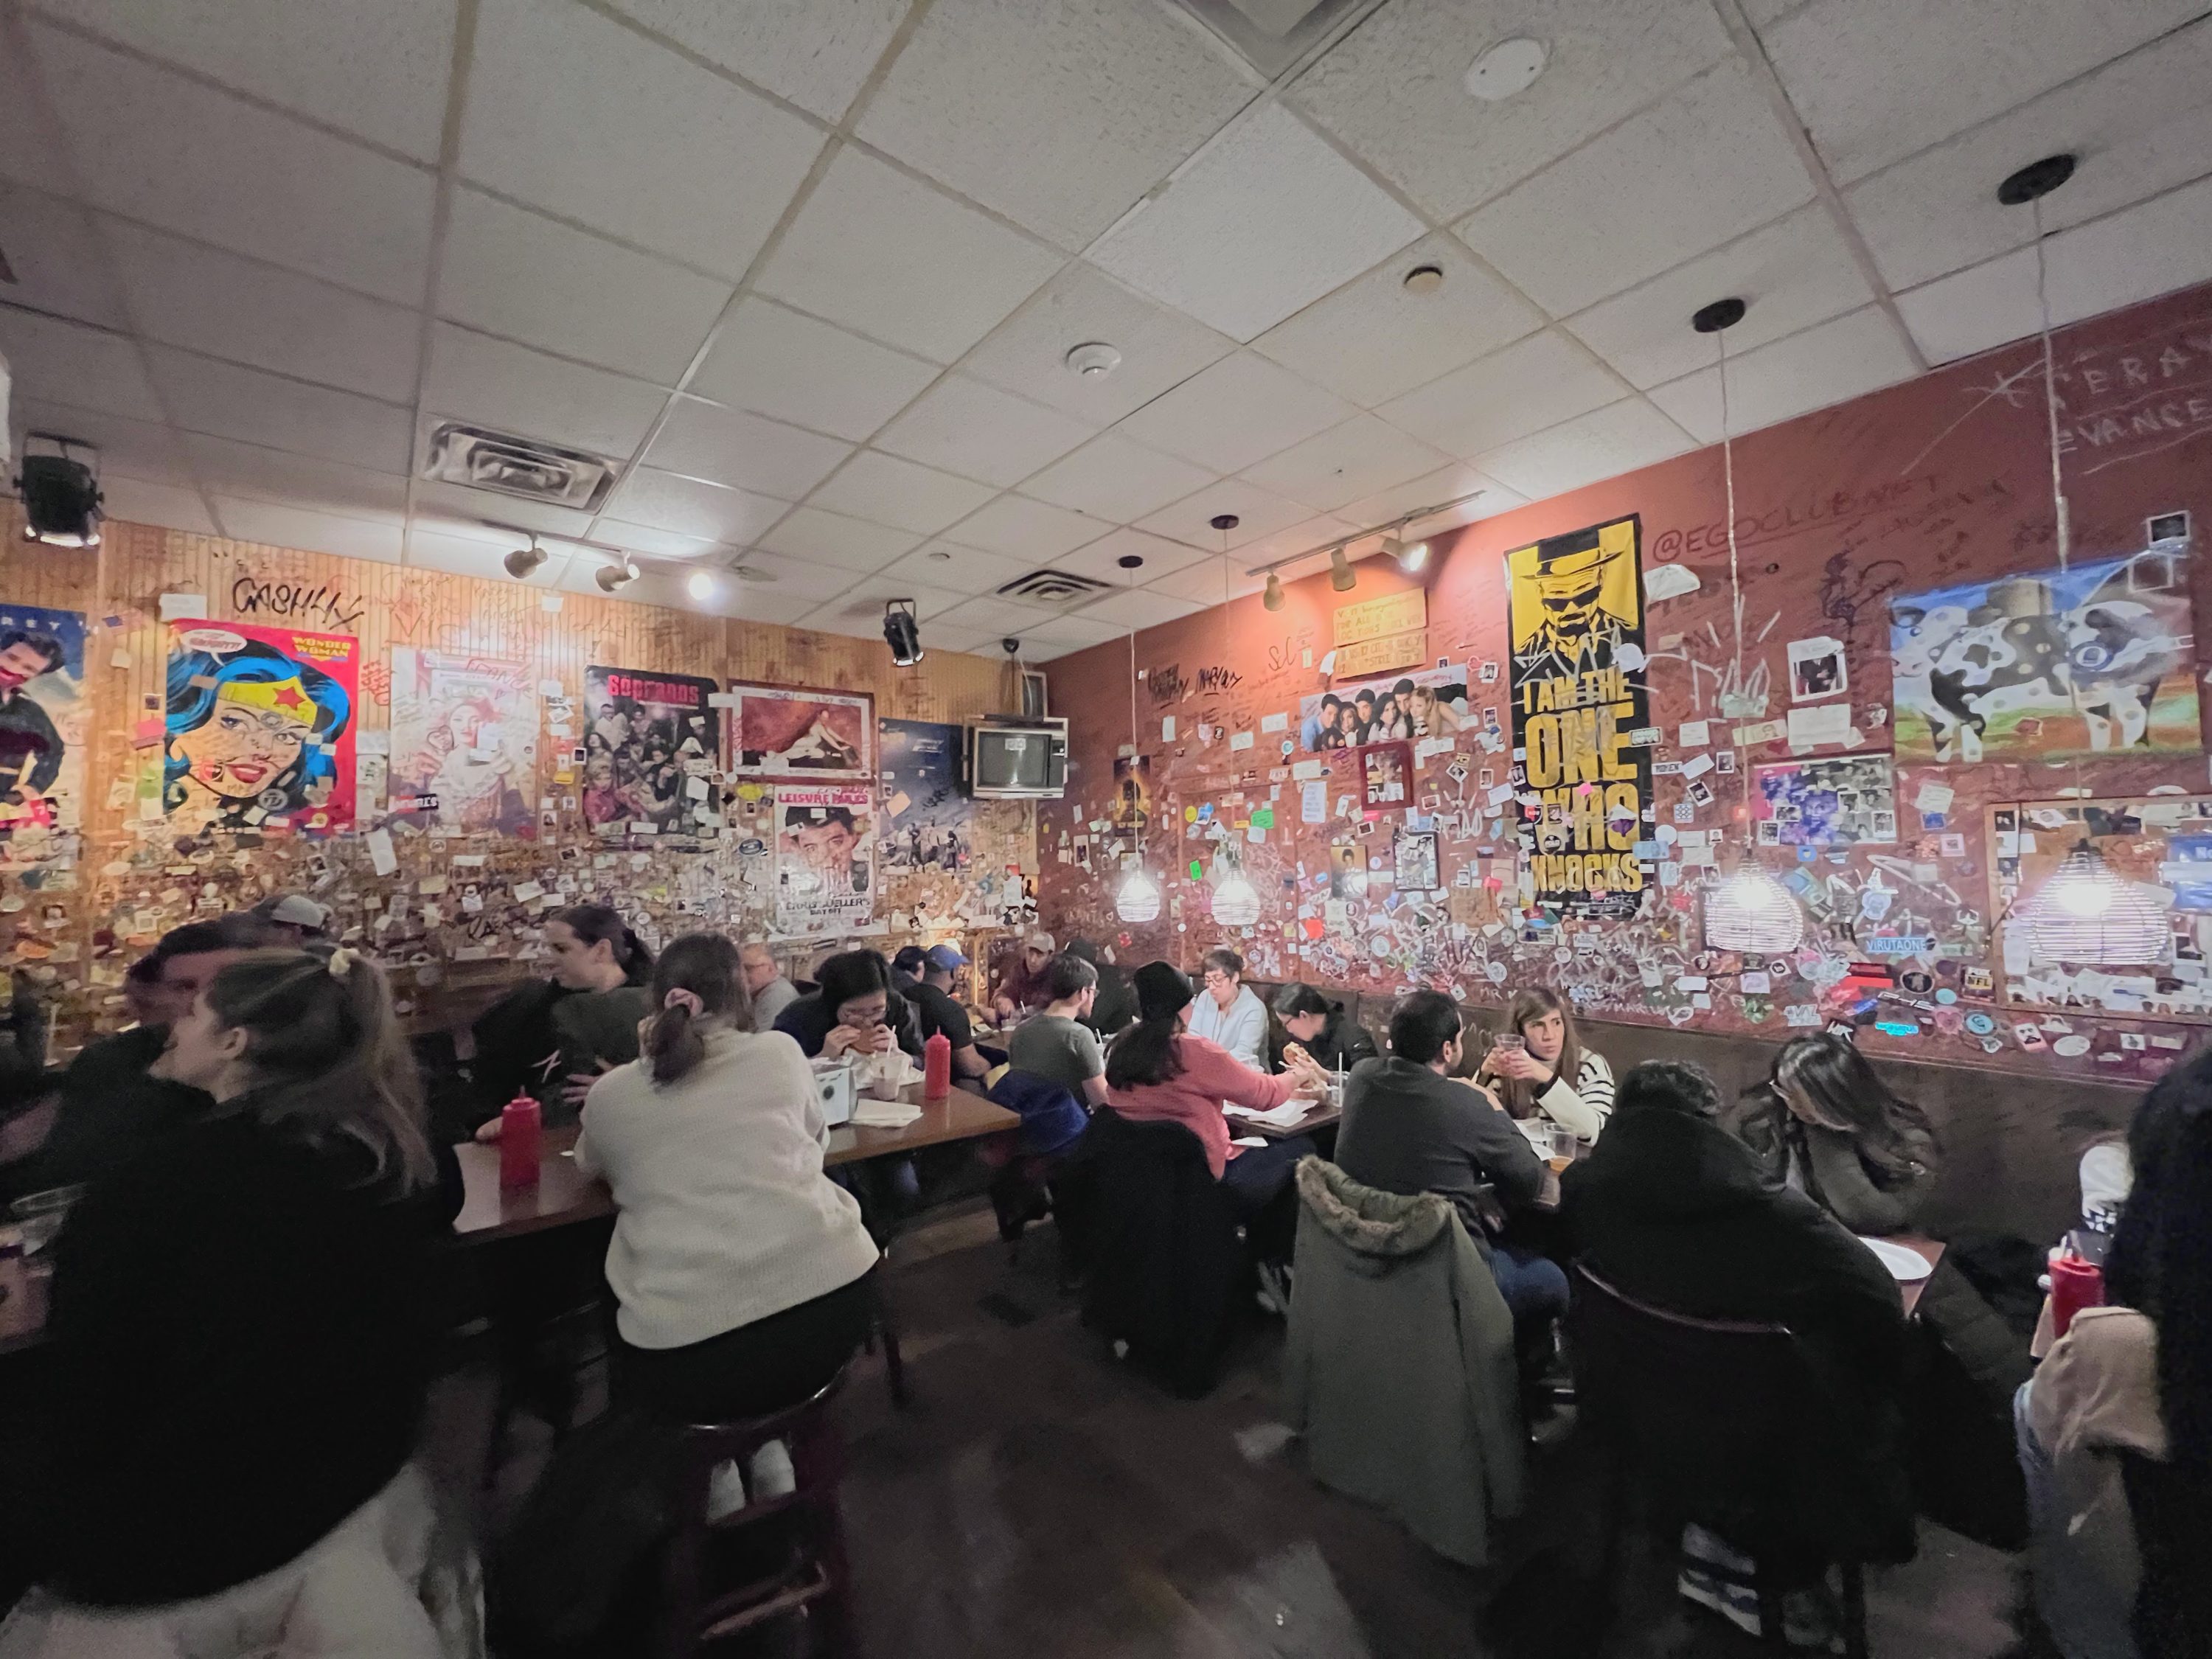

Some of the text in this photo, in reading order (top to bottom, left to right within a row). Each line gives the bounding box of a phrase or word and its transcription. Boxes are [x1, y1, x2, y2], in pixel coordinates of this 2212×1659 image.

[292, 637, 352, 651] WONDER
[294, 645, 349, 658] WOMAN
[1523, 665, 1634, 714] I AM THE
[1525, 701, 1638, 788] ONE
[778, 793, 830, 804] LEISURE
[1530, 853, 1643, 893] KNOCKS
